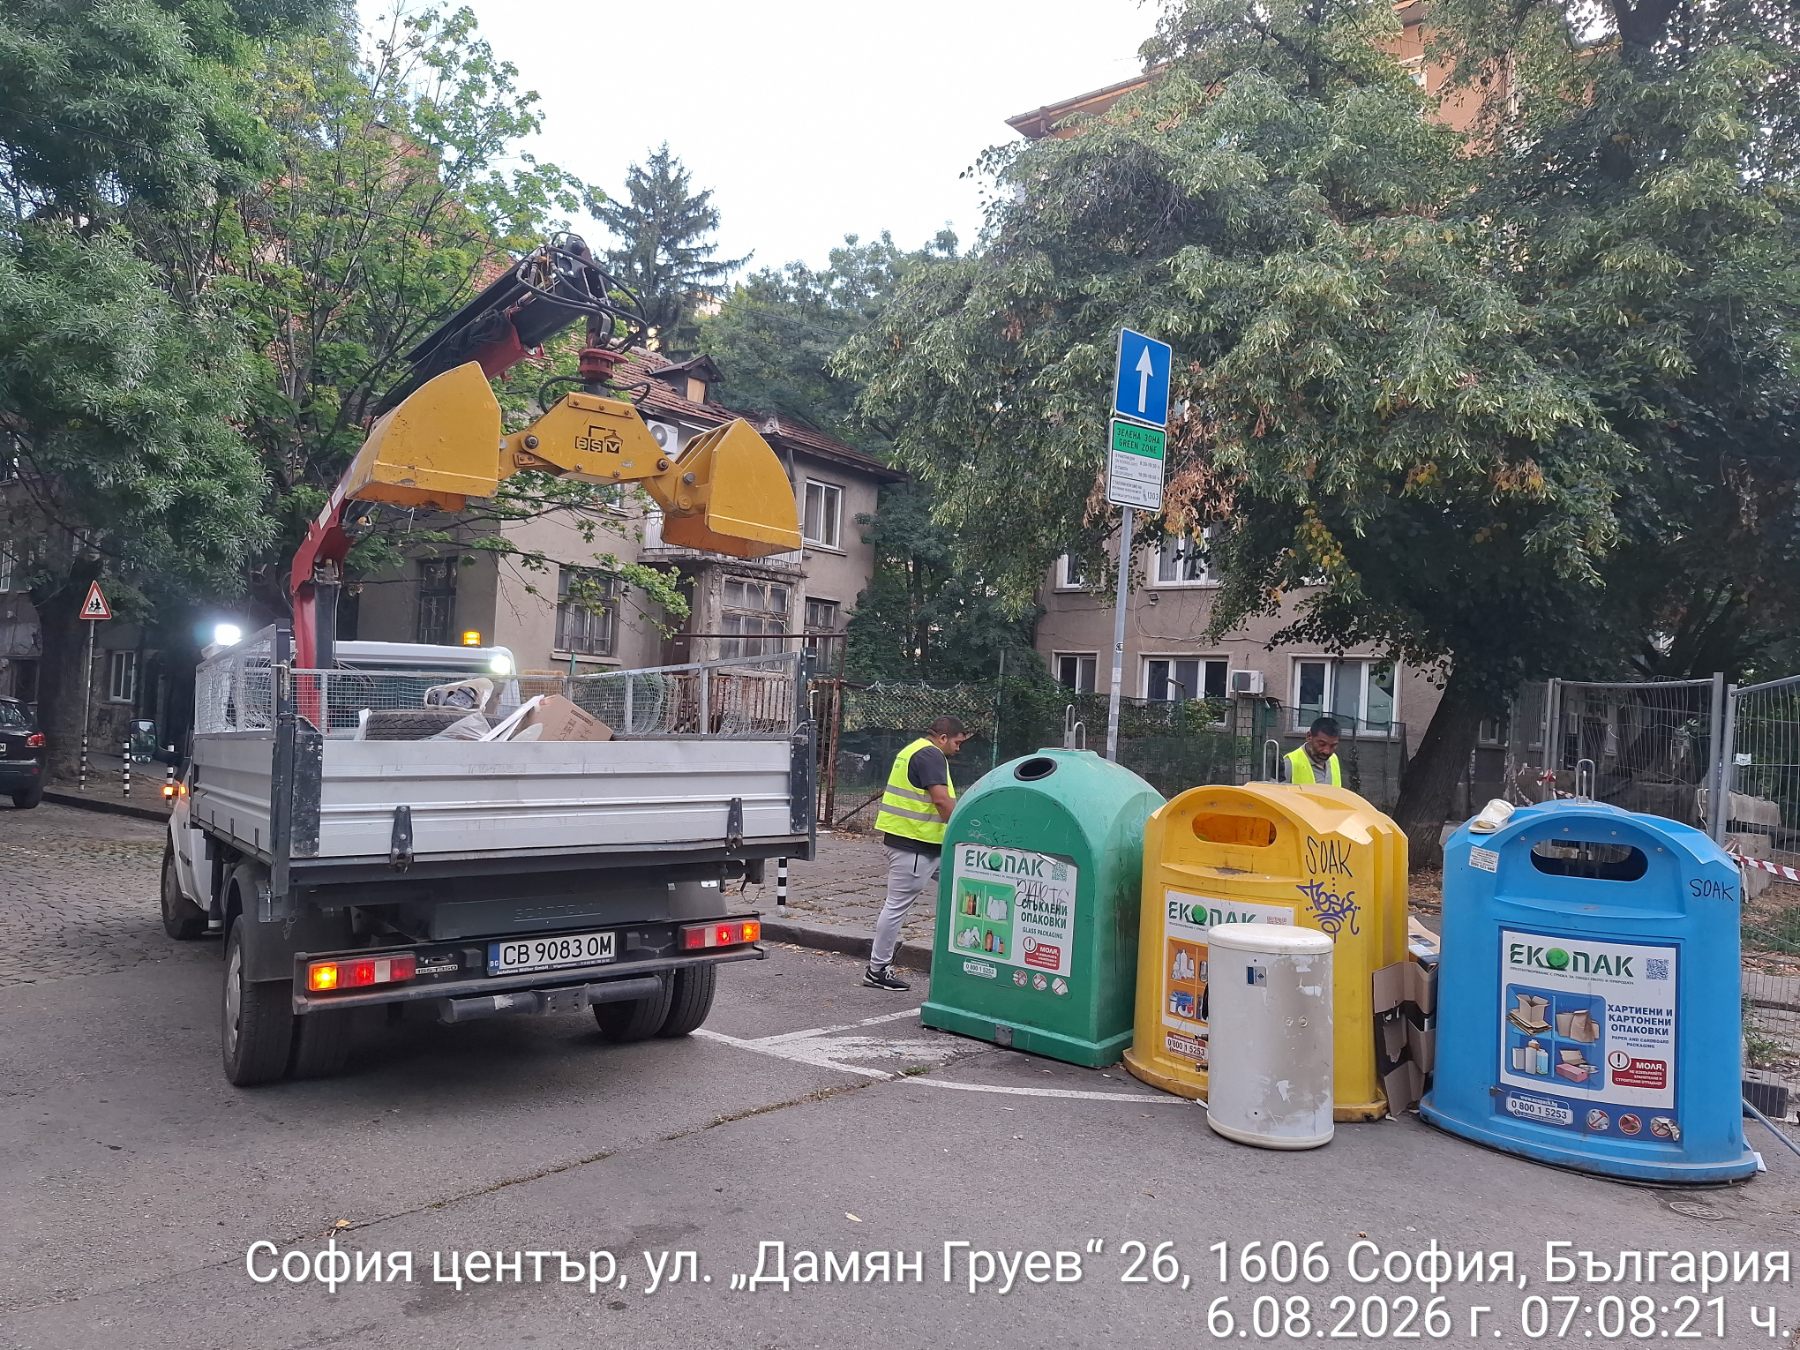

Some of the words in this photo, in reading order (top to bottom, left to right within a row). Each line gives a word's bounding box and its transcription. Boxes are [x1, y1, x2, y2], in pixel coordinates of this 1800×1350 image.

[1117, 428, 1141, 440] ЗЕЛЕНА
[1144, 434, 1160, 444] ЗОНА
[575, 436, 620, 454] BSV
[1119, 438, 1139, 450] GREEN
[1142, 443, 1159, 454] ZONE
[965, 849, 1044, 878] ЕКОПАК
[1305, 835, 1353, 878] SOAK
[1689, 878, 1735, 902] SOAK
[1021, 899, 1068, 916] СТЪКЛЕНИ
[1021, 911, 1067, 929] ОПАКОВКИ
[1022, 926, 1037, 935] GLASS
[1037, 929, 1063, 940] PACKAGING
[503, 944, 530, 966] CB
[535, 939, 583, 963] 9083
[587, 935, 612, 956] OM
[1510, 943, 1635, 978] ЕКОПАК
[1607, 1004, 1663, 1016] ХАРТИЕНИ
[1666, 1009, 1673, 1017] И
[1608, 1014, 1672, 1026] КАРТОНЕНИ
[1611, 1023, 1669, 1036] ОПАКОВКИ
[1167, 1038, 1172, 1046] 0
[1636, 1061, 1665, 1072] МОЛЯ,
[1511, 1100, 1517, 1108] 0
[1519, 1101, 1535, 1113] 800
[1537, 1106, 1542, 1114] 1
[1545, 1107, 1567, 1120] 5253
